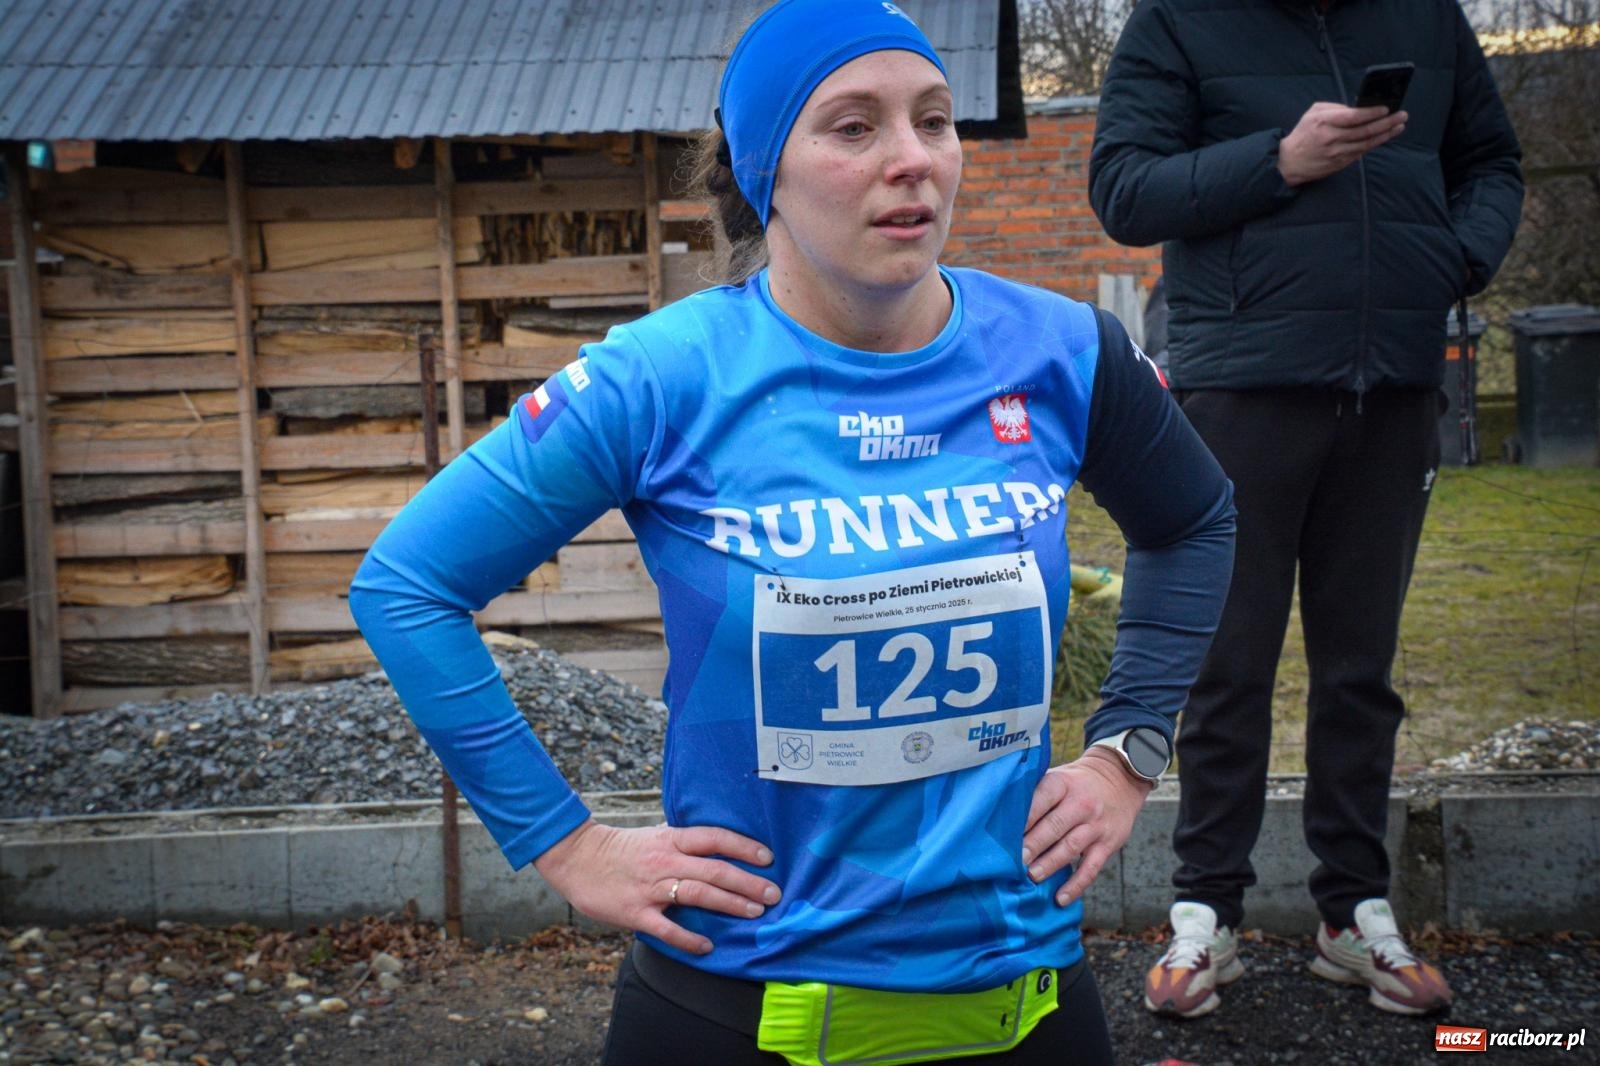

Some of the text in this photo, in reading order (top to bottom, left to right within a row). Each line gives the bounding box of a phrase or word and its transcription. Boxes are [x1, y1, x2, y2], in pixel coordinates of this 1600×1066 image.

[995, 384, 1037, 393] POLAND
[777, 567, 1023, 606] IX Eko Cross po Ziemi Pietrowickiej
[833, 612, 874, 622] Pietrowice
[875, 608, 904, 619] Wielkie,
[905, 606, 915, 615] 25
[915, 602, 947, 615] stycznia
[948, 600, 966, 609] 2025
[813, 621, 998, 722] 125
[819, 750, 865, 758] PIETROWICE
[827, 759, 857, 767] WIELKIE
